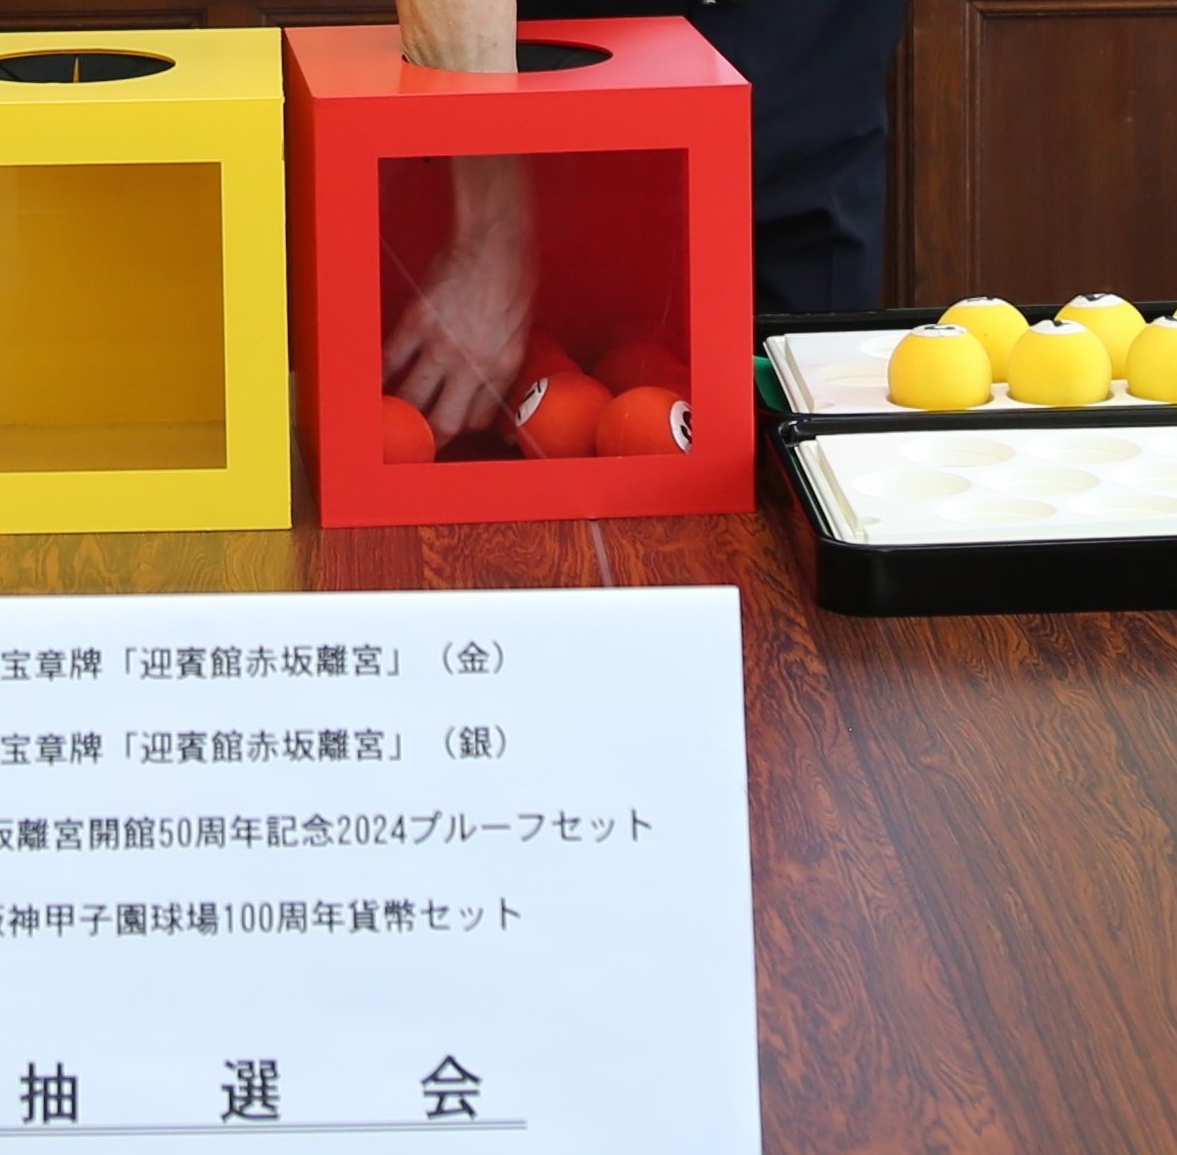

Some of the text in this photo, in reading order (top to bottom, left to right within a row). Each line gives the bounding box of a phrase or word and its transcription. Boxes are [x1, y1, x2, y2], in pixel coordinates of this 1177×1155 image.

[19, 1055, 481, 1123] 抽 選 会
